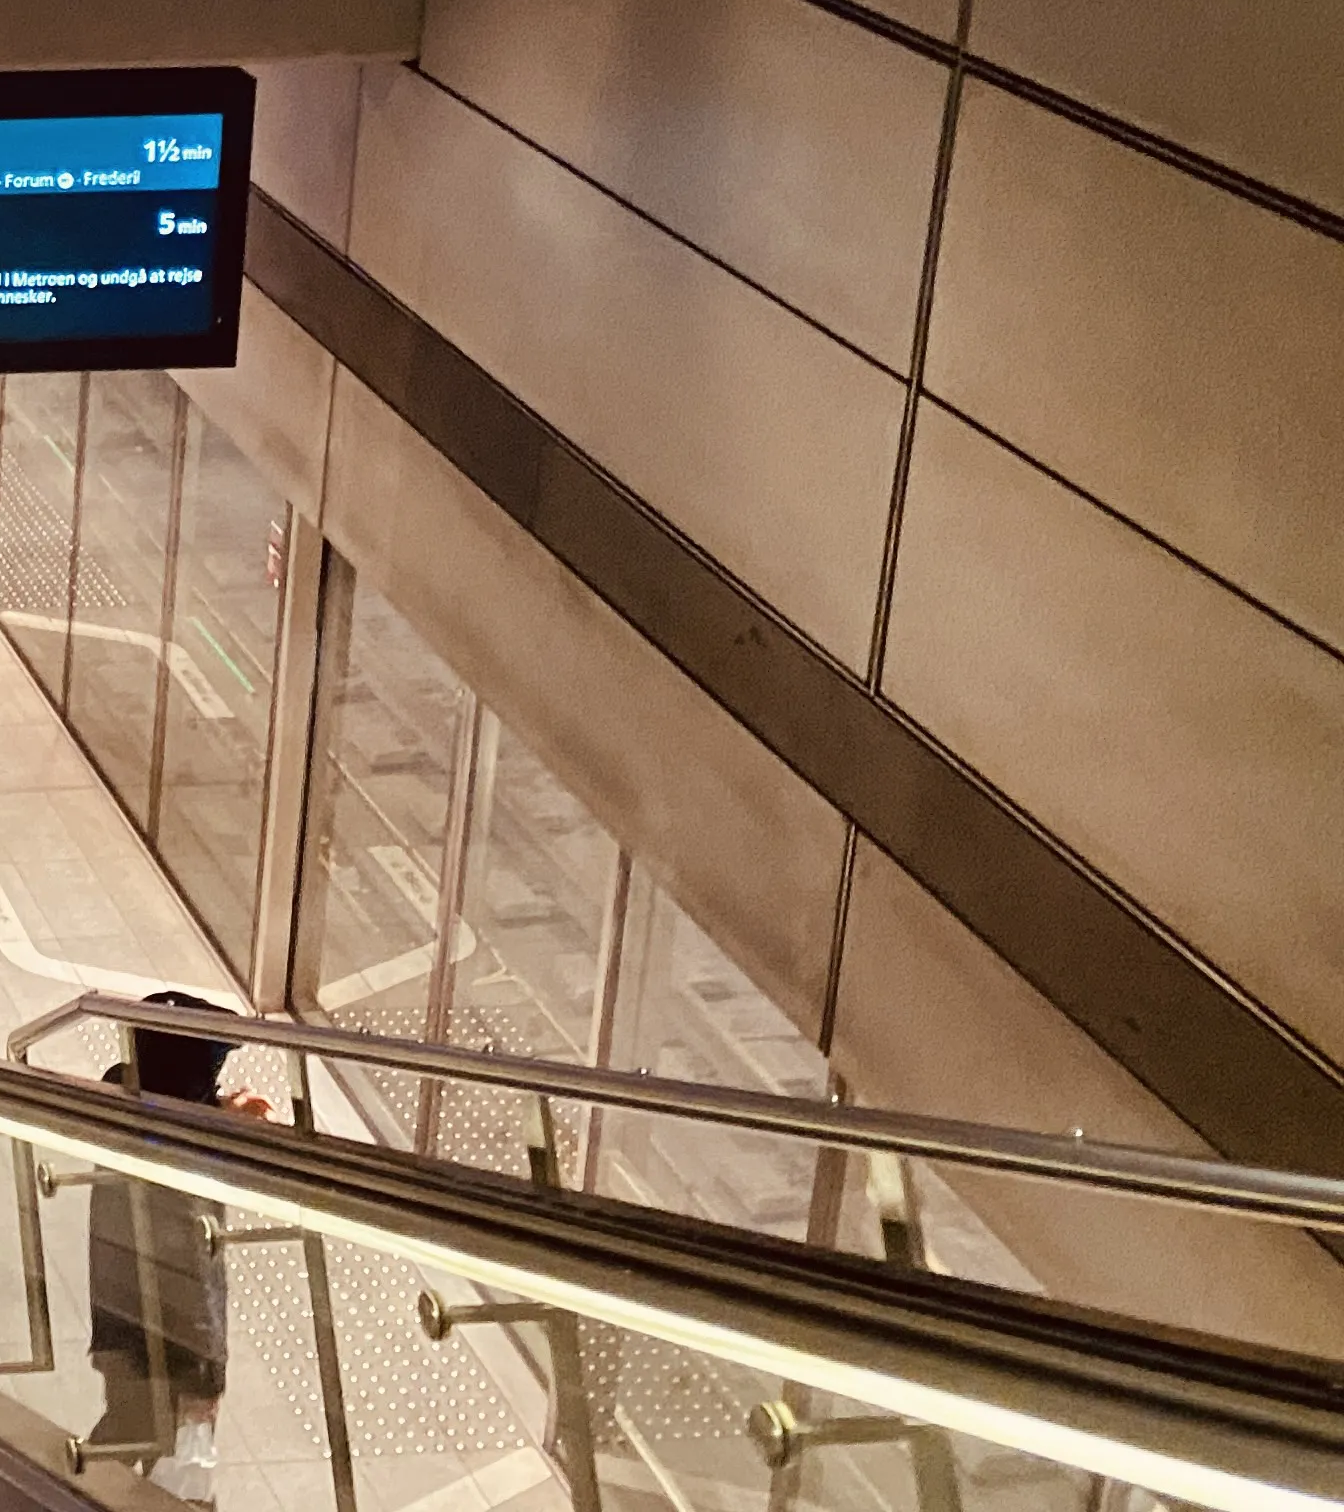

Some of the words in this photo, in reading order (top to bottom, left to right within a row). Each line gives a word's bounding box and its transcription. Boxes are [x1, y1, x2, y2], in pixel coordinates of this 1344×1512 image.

[143, 139, 180, 162] 1½
[182, 145, 212, 160] min
[4, 174, 54, 188] Forum
[159, 212, 175, 235] 5
[177, 219, 208, 234] min
[13, 271, 76, 287] Metroen
[77, 273, 98, 288] og
[100, 268, 148, 287] undgå
[149, 269, 166, 283] at
[167, 267, 203, 285] rejse
